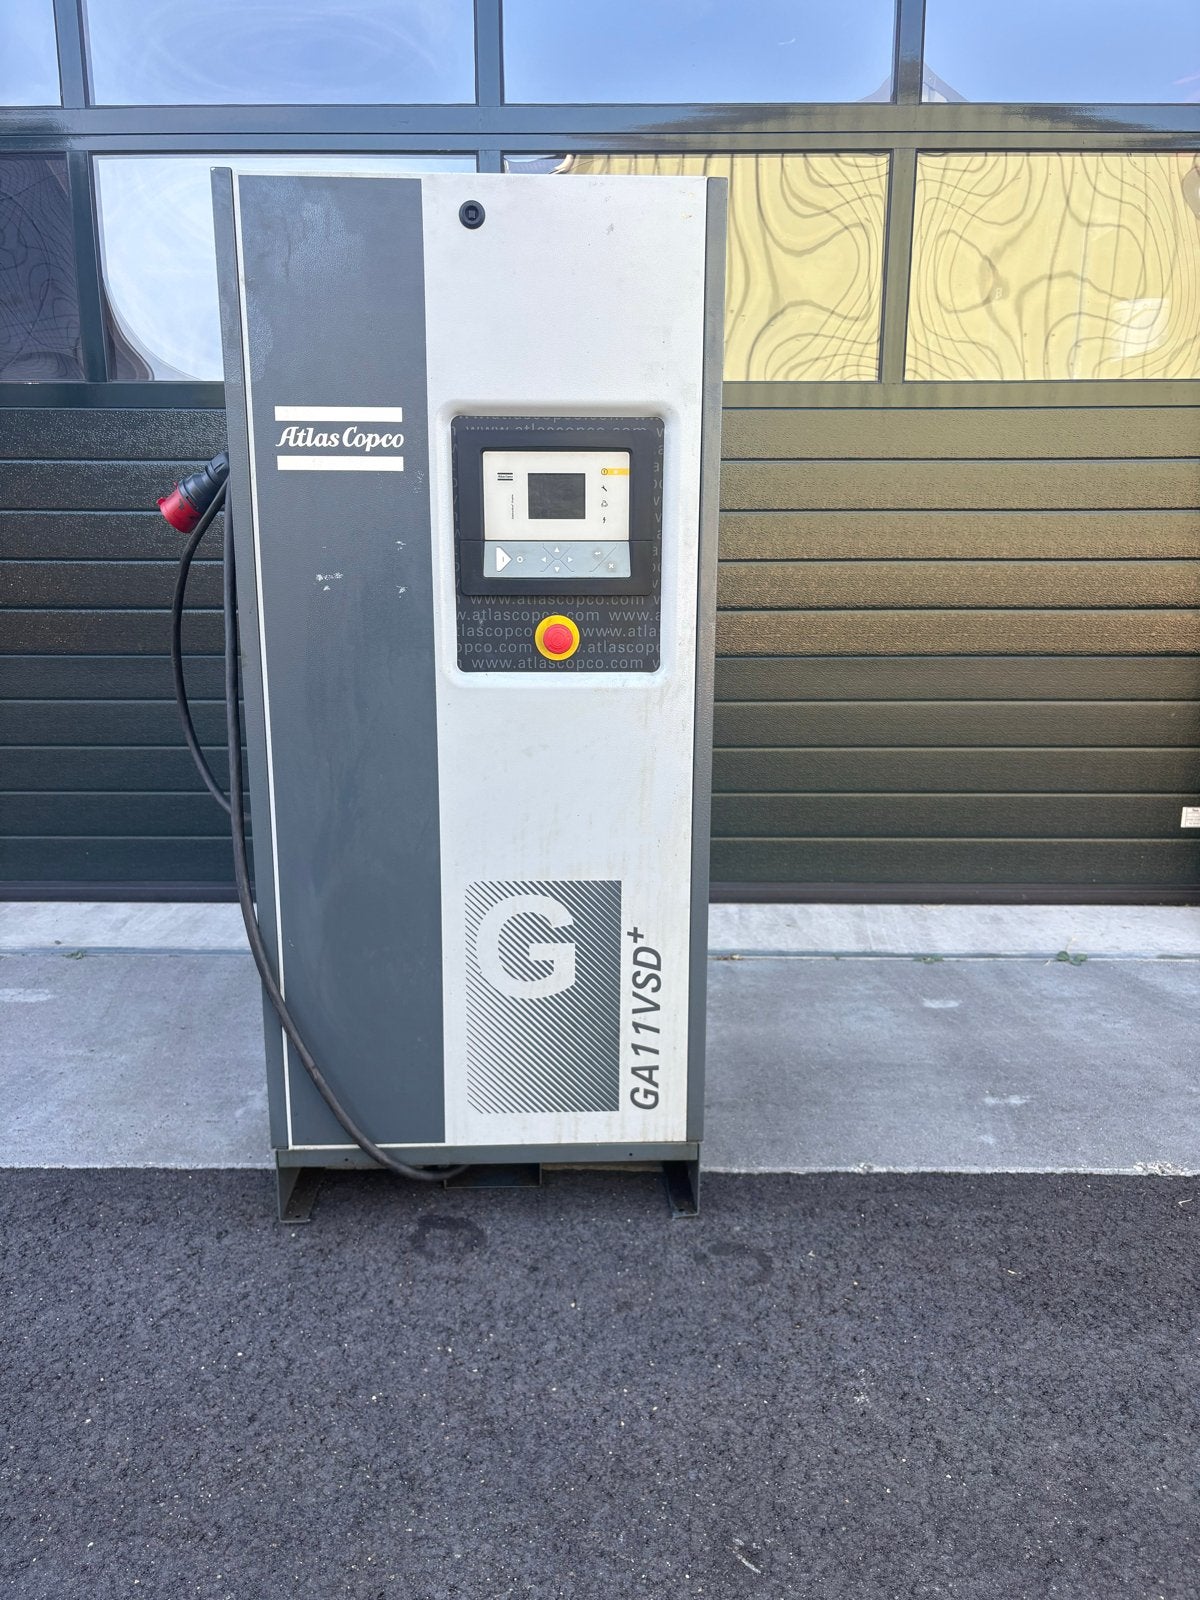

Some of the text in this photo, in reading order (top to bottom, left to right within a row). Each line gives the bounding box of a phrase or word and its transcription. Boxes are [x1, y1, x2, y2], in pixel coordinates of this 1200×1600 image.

[275, 426, 405, 452] Atlas Copco
[457, 624, 657, 639] lascopco www.atla
[472, 657, 643, 671] www.atlascopco.com
[476, 894, 576, 999] G
